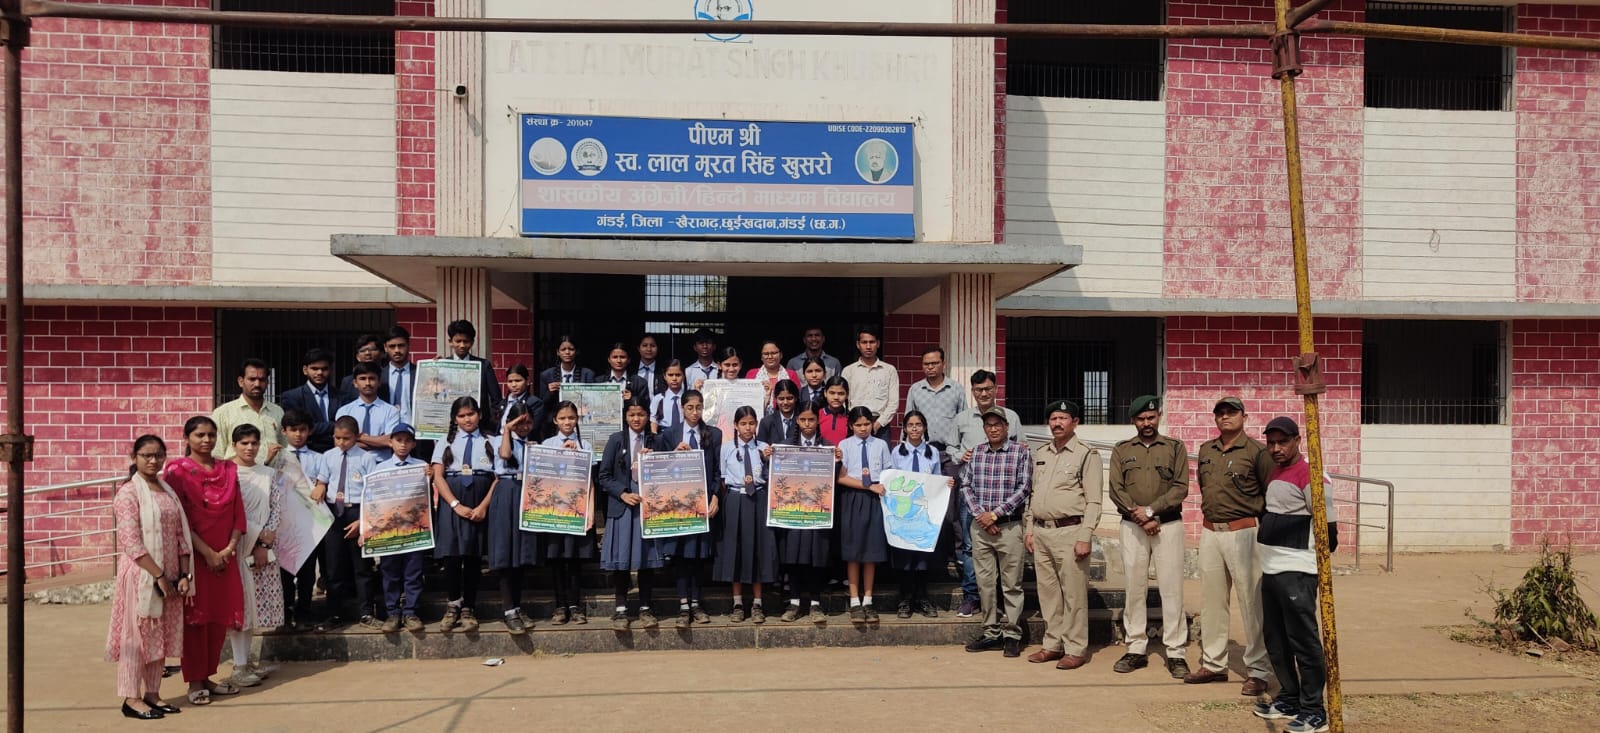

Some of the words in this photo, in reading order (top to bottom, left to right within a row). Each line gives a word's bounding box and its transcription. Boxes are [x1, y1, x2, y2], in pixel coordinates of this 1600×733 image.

[525, 117, 548, 127] संस्था
[566, 119, 593, 128] 201047
[828, 124, 846, 133] UDISE
[688, 121, 734, 146] पीएम
[739, 122, 762, 147] श्री
[614, 152, 642, 173] स्व.
[648, 153, 690, 174] लाल
[695, 154, 737, 178] मूरत
[741, 149, 777, 176] सिंह
[781, 151, 833, 179] खुसरो
[537, 184, 622, 204] शासकीय
[628, 184, 747, 208] अंग्रेजी/हिन्दी
[754, 189, 816, 206] माध्यम
[824, 187, 896, 208] विद्यालय
[596, 213, 628, 229] गंडई,
[631, 213, 663, 229] जिला
[809, 217, 846, 231] (छ.ग.)
